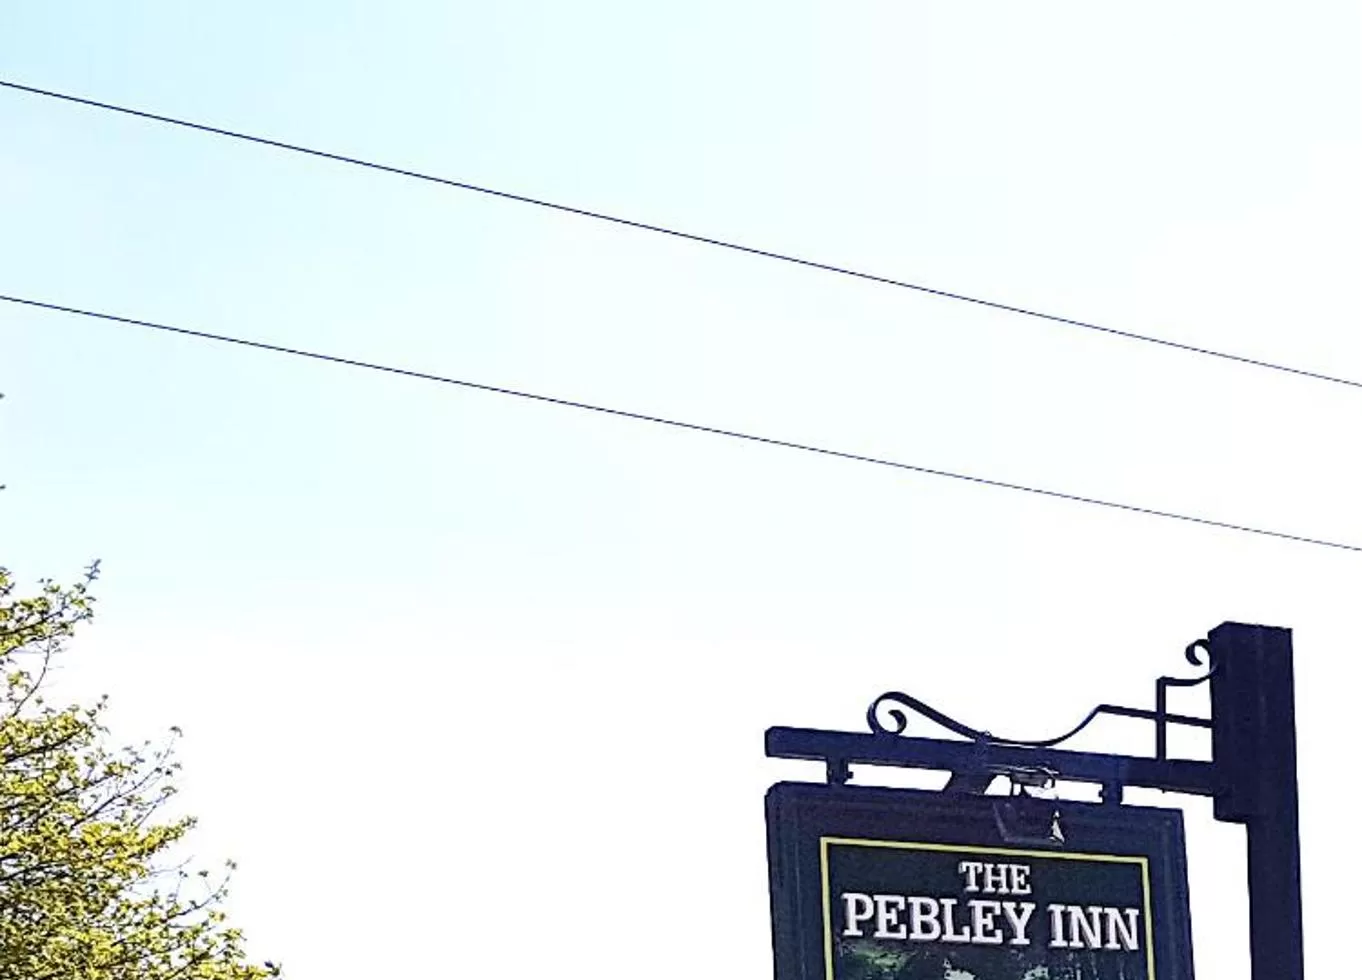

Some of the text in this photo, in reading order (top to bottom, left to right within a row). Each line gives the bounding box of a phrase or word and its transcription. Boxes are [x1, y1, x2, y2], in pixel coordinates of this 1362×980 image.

[958, 861, 1032, 895] THE
[842, 892, 1140, 951] PEBLEY INN
